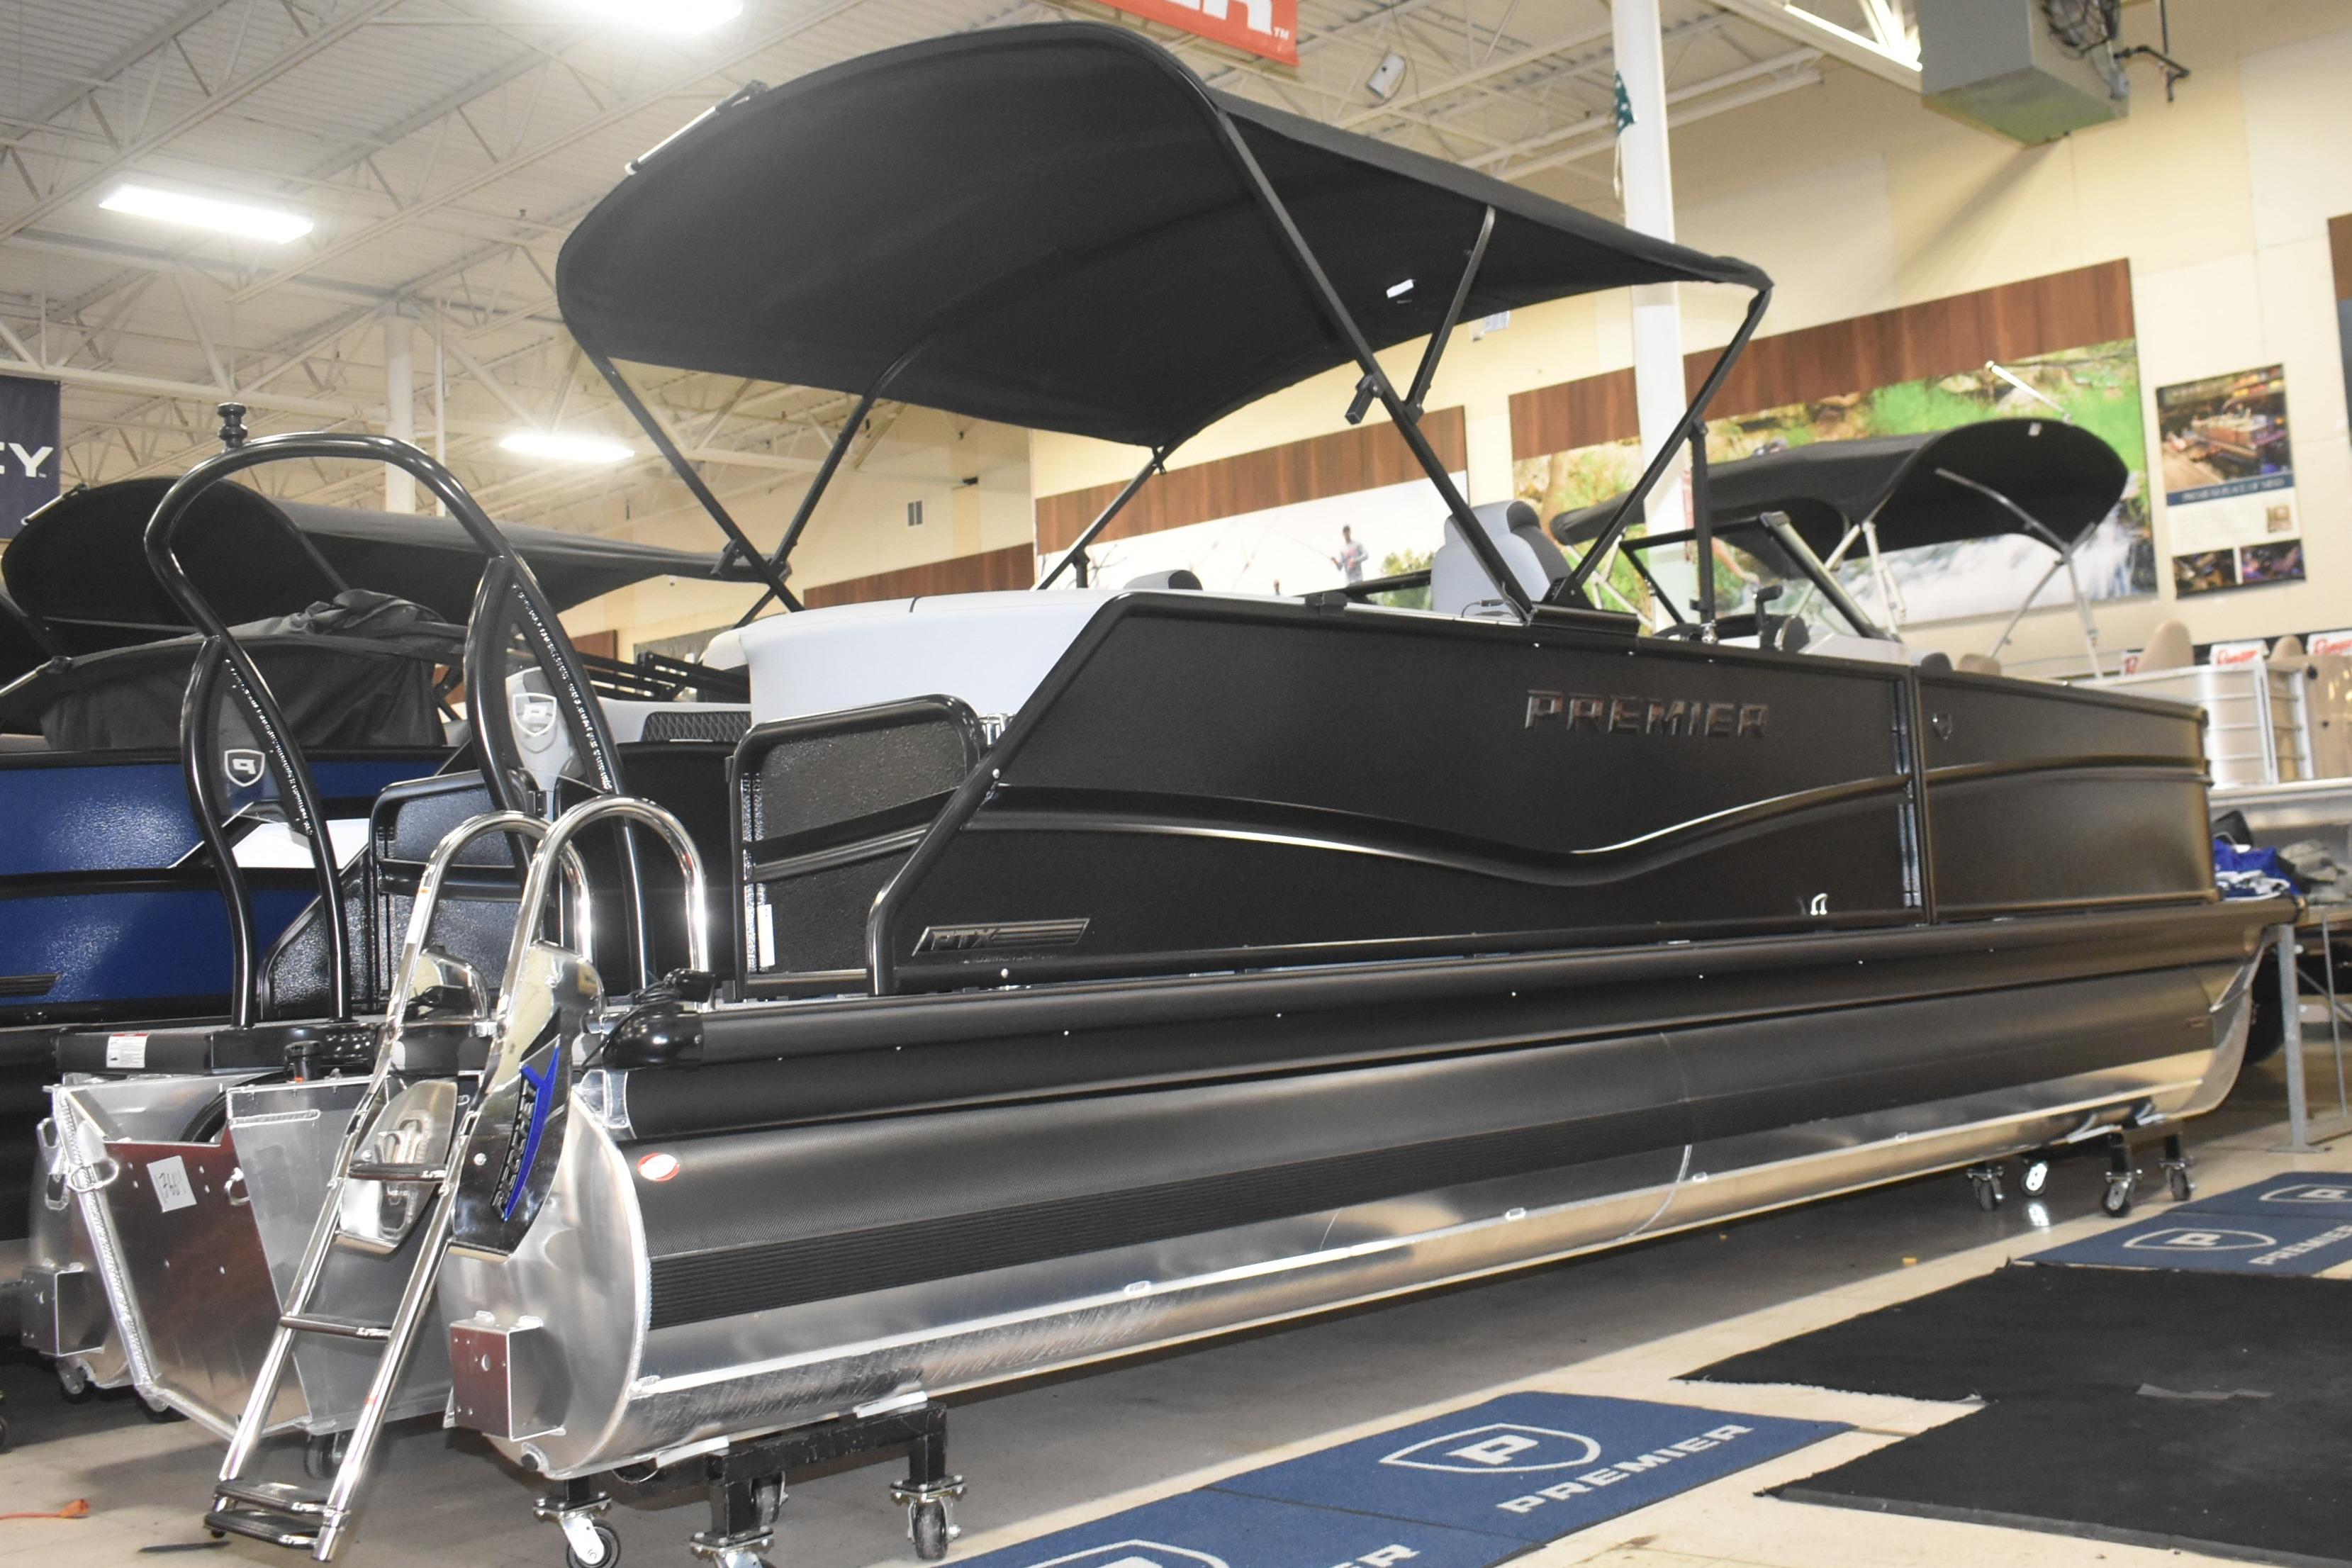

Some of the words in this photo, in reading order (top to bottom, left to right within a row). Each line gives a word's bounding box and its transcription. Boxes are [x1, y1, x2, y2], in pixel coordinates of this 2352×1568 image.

[1525, 688, 1769, 737] PREMIER
[929, 928, 1001, 952] PTX
[492, 1078, 537, 1219] RICOCHET
[1444, 1433, 1540, 1466] P
[1495, 1423, 1756, 1514] PREMIER
